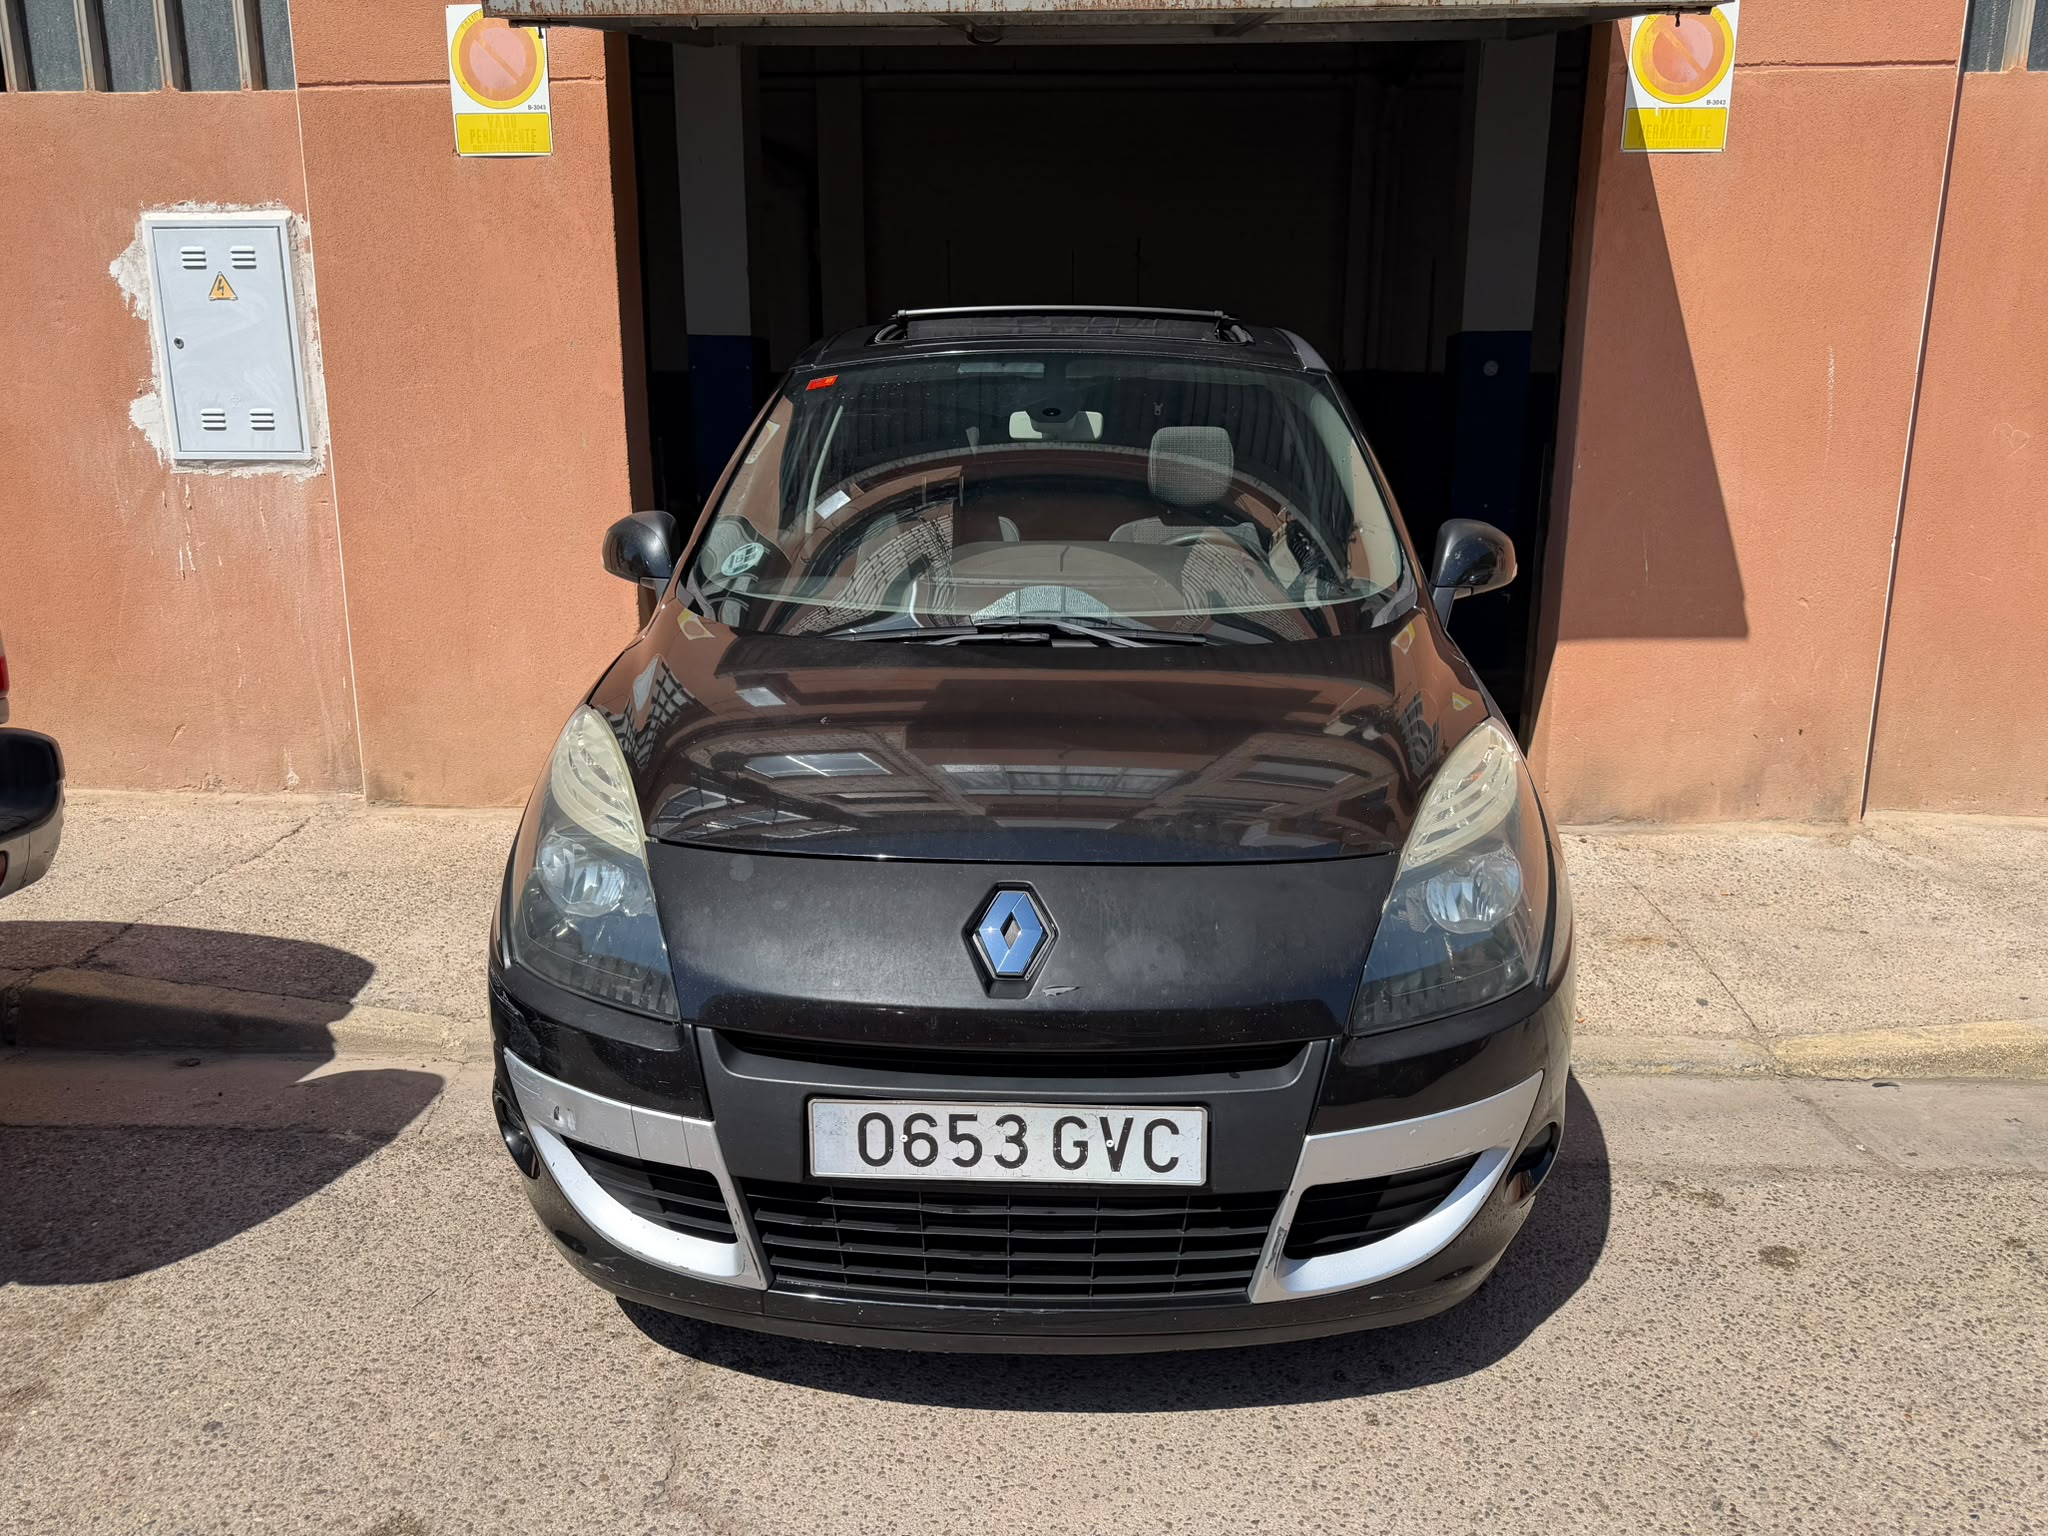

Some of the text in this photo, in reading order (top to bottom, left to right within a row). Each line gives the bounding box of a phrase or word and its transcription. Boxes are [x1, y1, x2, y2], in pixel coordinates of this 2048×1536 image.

[487, 115, 517, 128] VADO
[1661, 109, 1693, 124] VADO
[470, 128, 537, 145] PERMANENTE
[857, 1112, 1180, 1174] 0653 GVC
